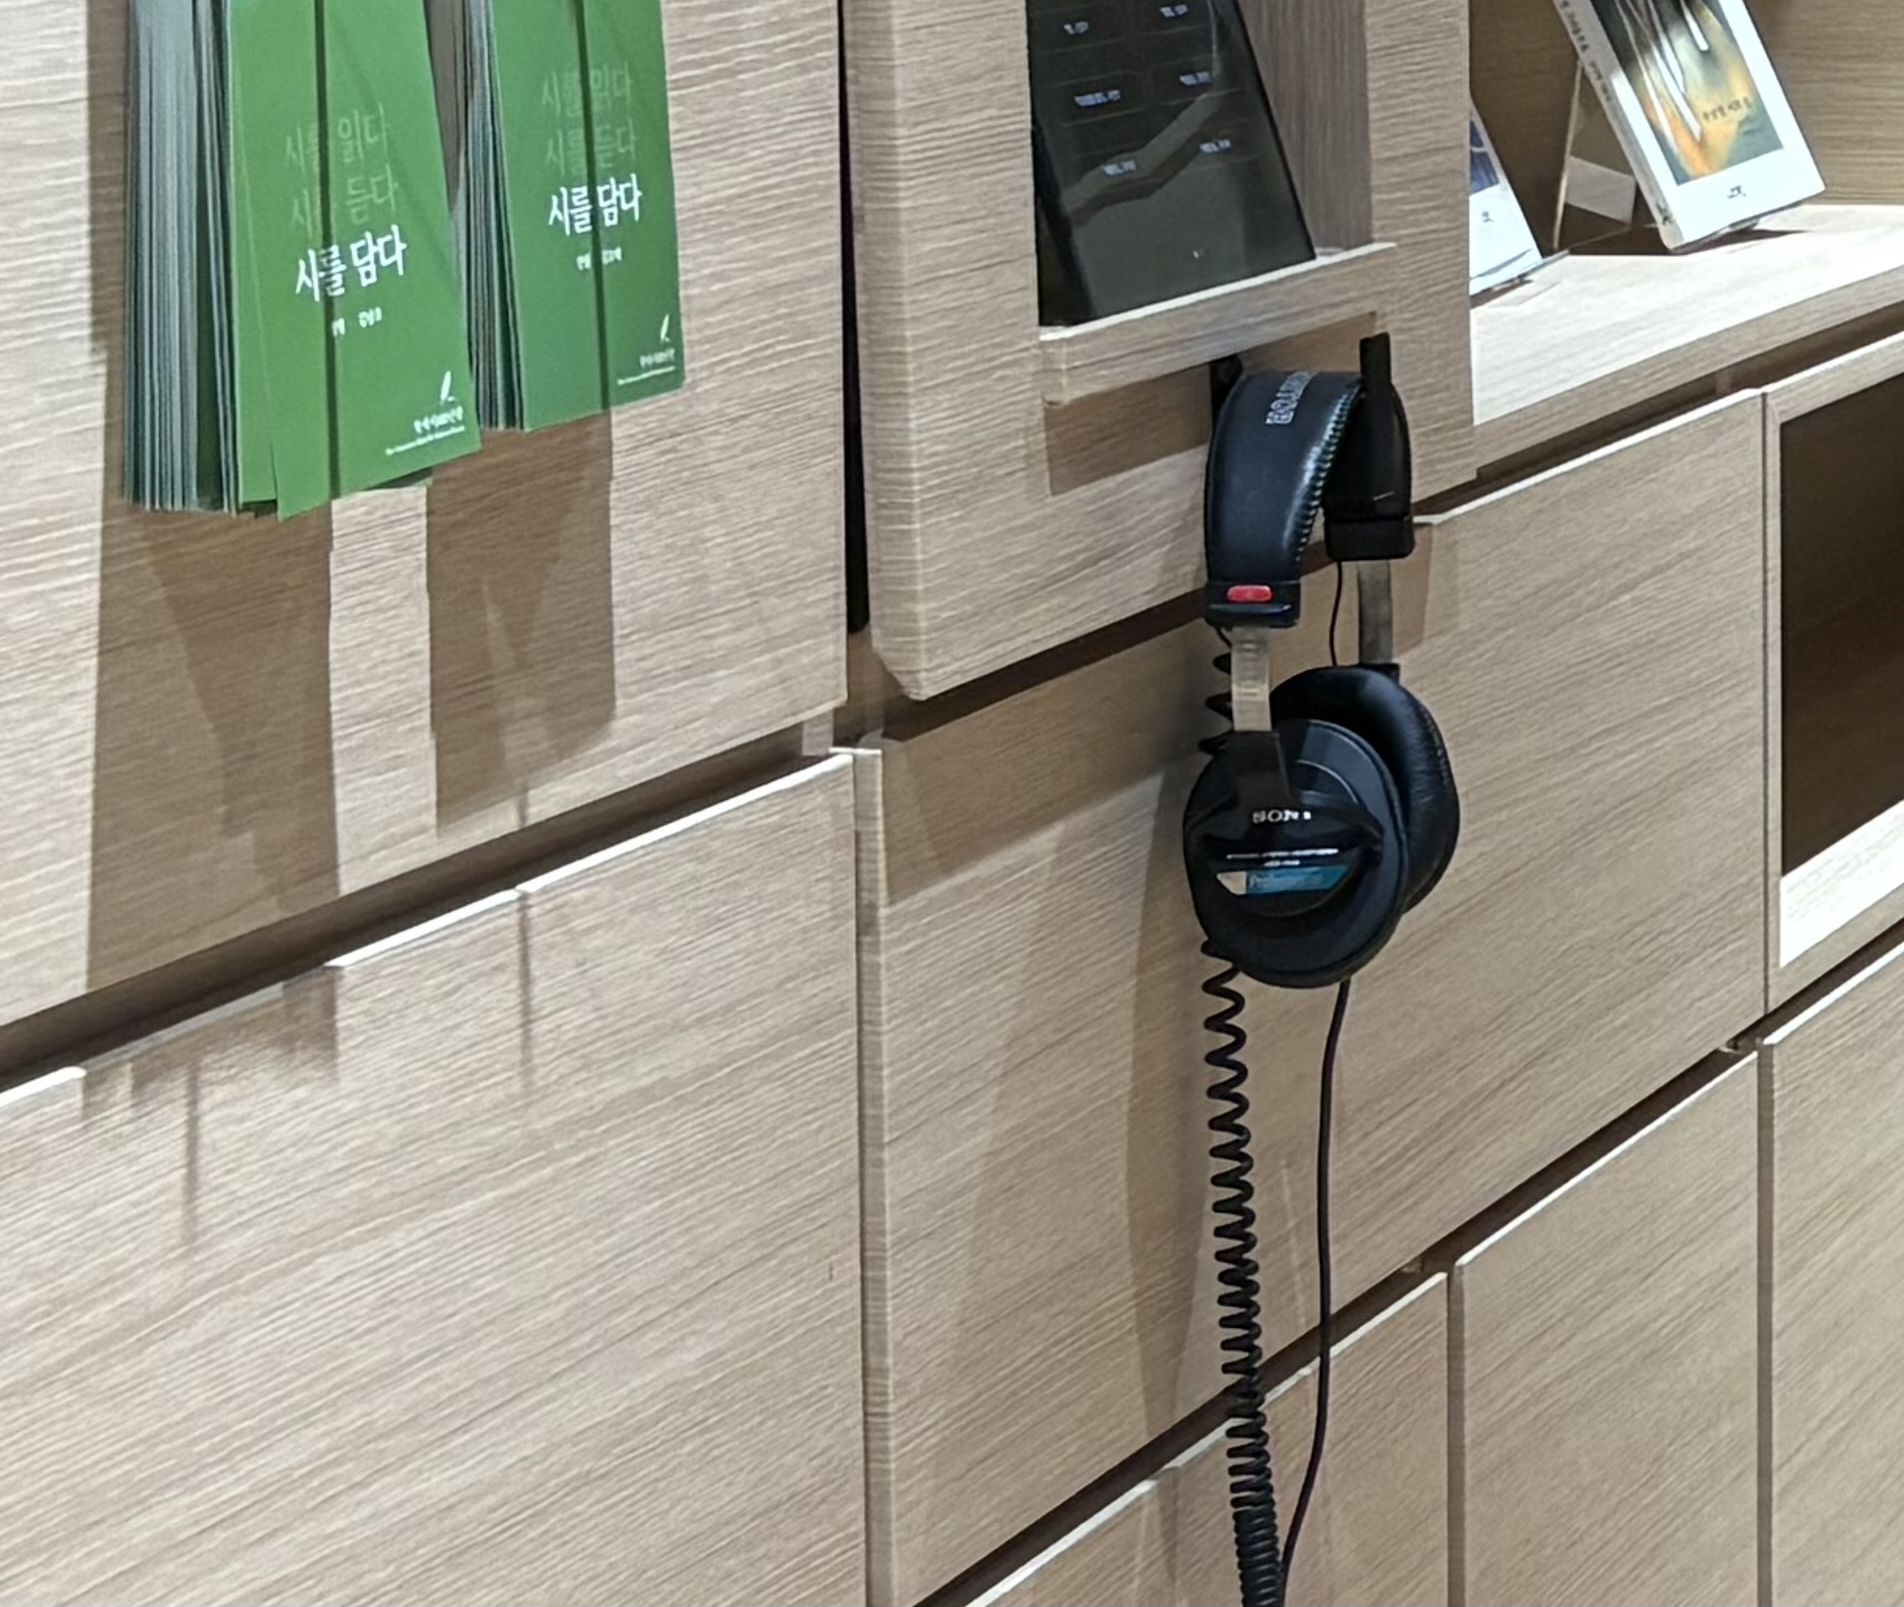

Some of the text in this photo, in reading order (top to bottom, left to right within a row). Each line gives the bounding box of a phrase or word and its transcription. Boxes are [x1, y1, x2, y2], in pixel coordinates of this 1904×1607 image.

[548, 172, 643, 236] 시를 담다
[295, 223, 408, 303] 시를 담다
